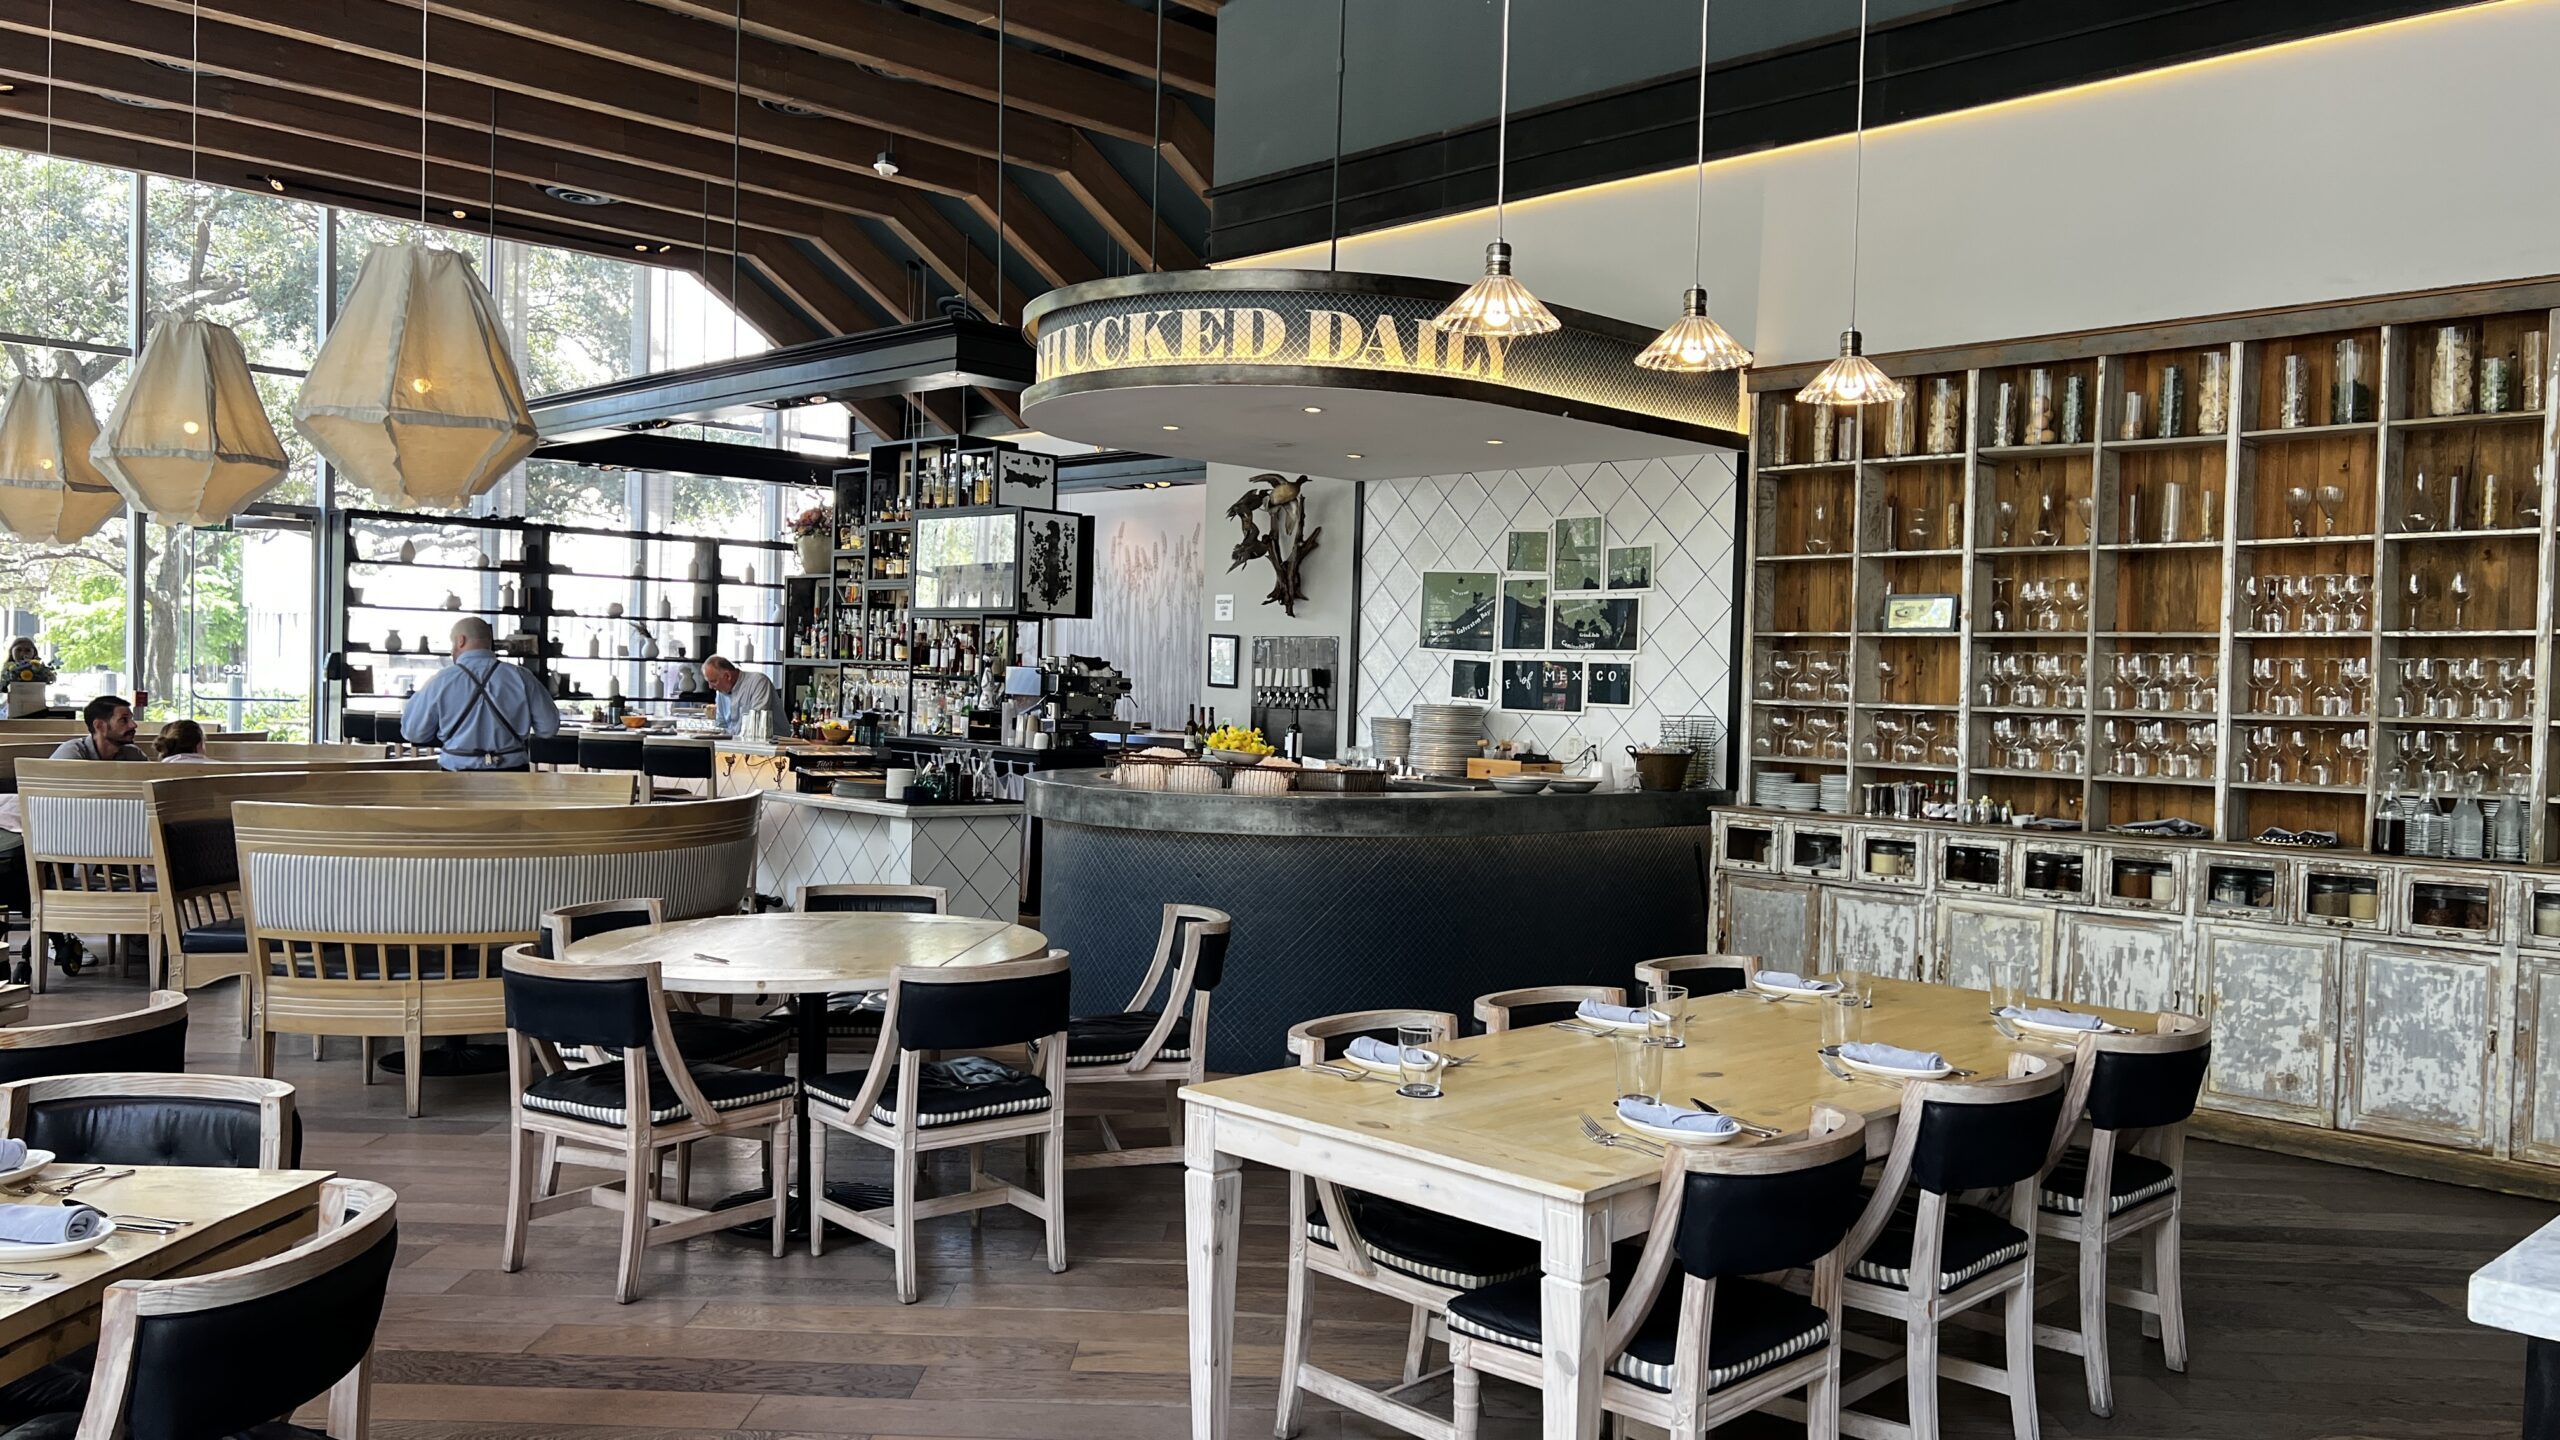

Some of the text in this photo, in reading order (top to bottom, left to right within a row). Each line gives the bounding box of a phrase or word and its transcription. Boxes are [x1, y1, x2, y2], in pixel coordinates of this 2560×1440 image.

[1305, 309, 1515, 382] DAILY
[1456, 609, 1491, 635] Galveston Bay
[1520, 670, 1534, 690] of
